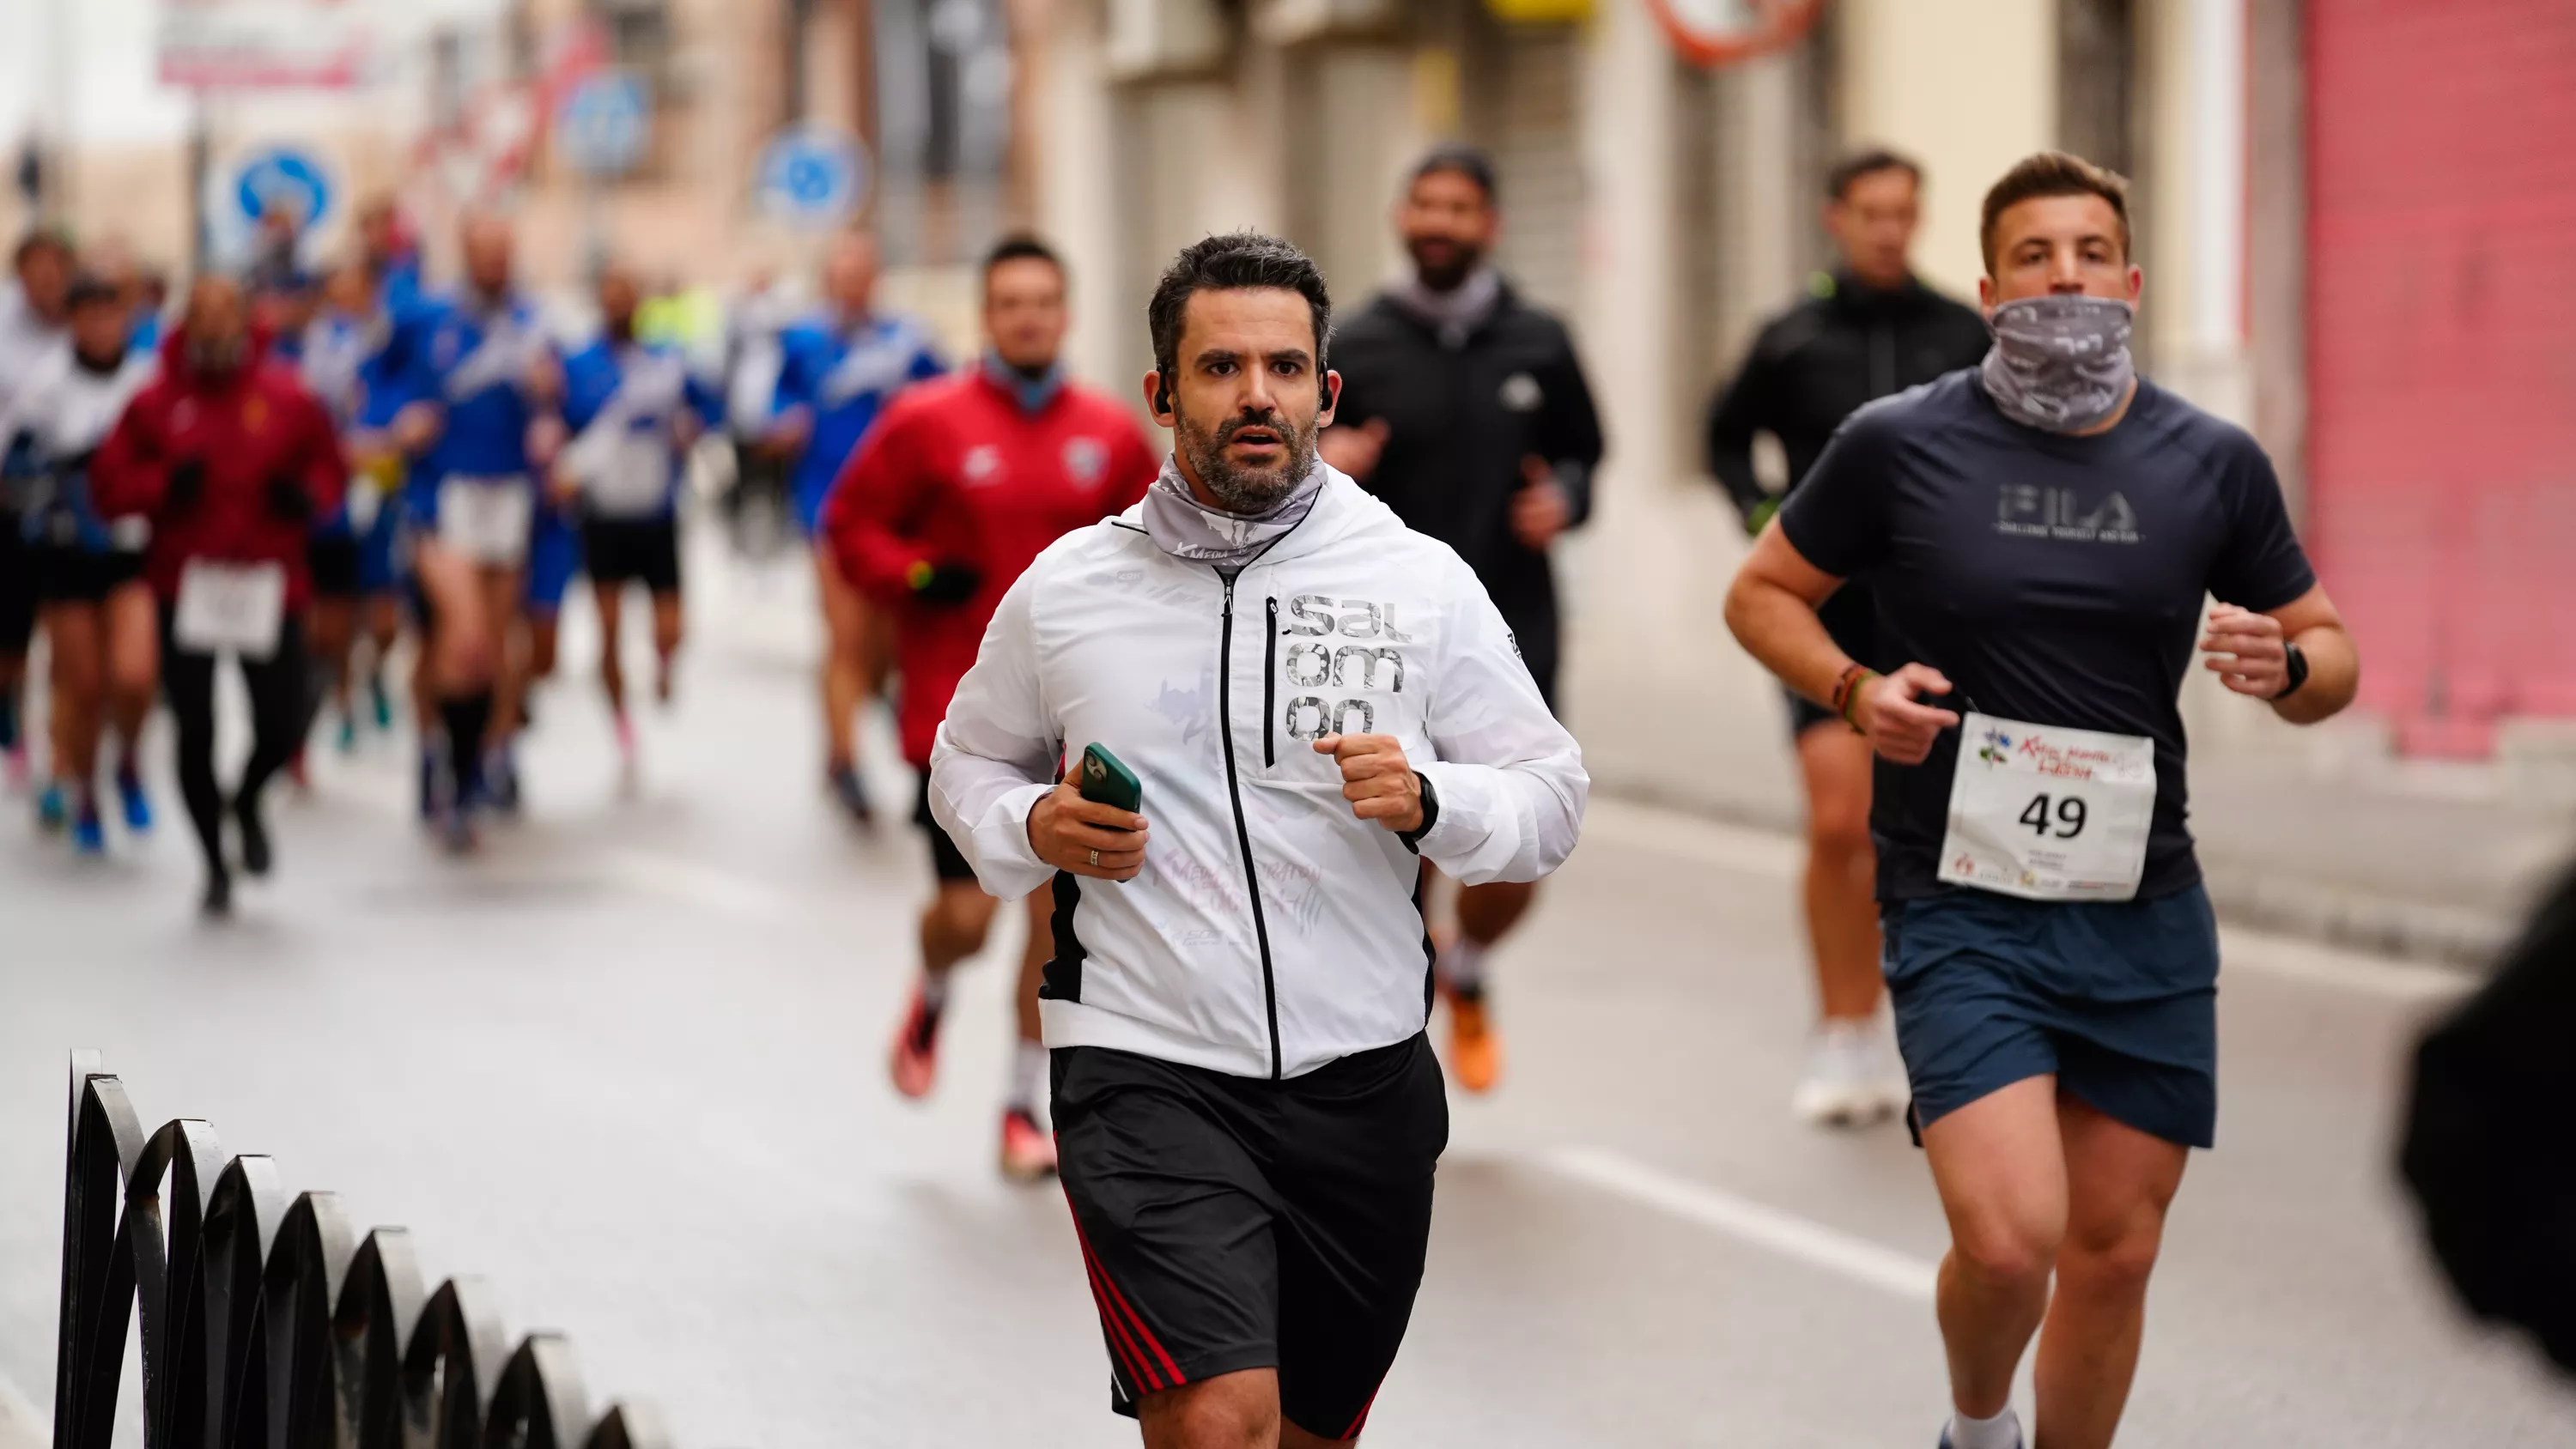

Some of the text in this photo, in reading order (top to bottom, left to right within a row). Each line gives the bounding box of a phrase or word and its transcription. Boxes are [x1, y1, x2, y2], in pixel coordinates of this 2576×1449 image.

[1998, 485, 2138, 529] FILA
[1286, 643, 1405, 693] om
[2019, 792, 2087, 839] 49
